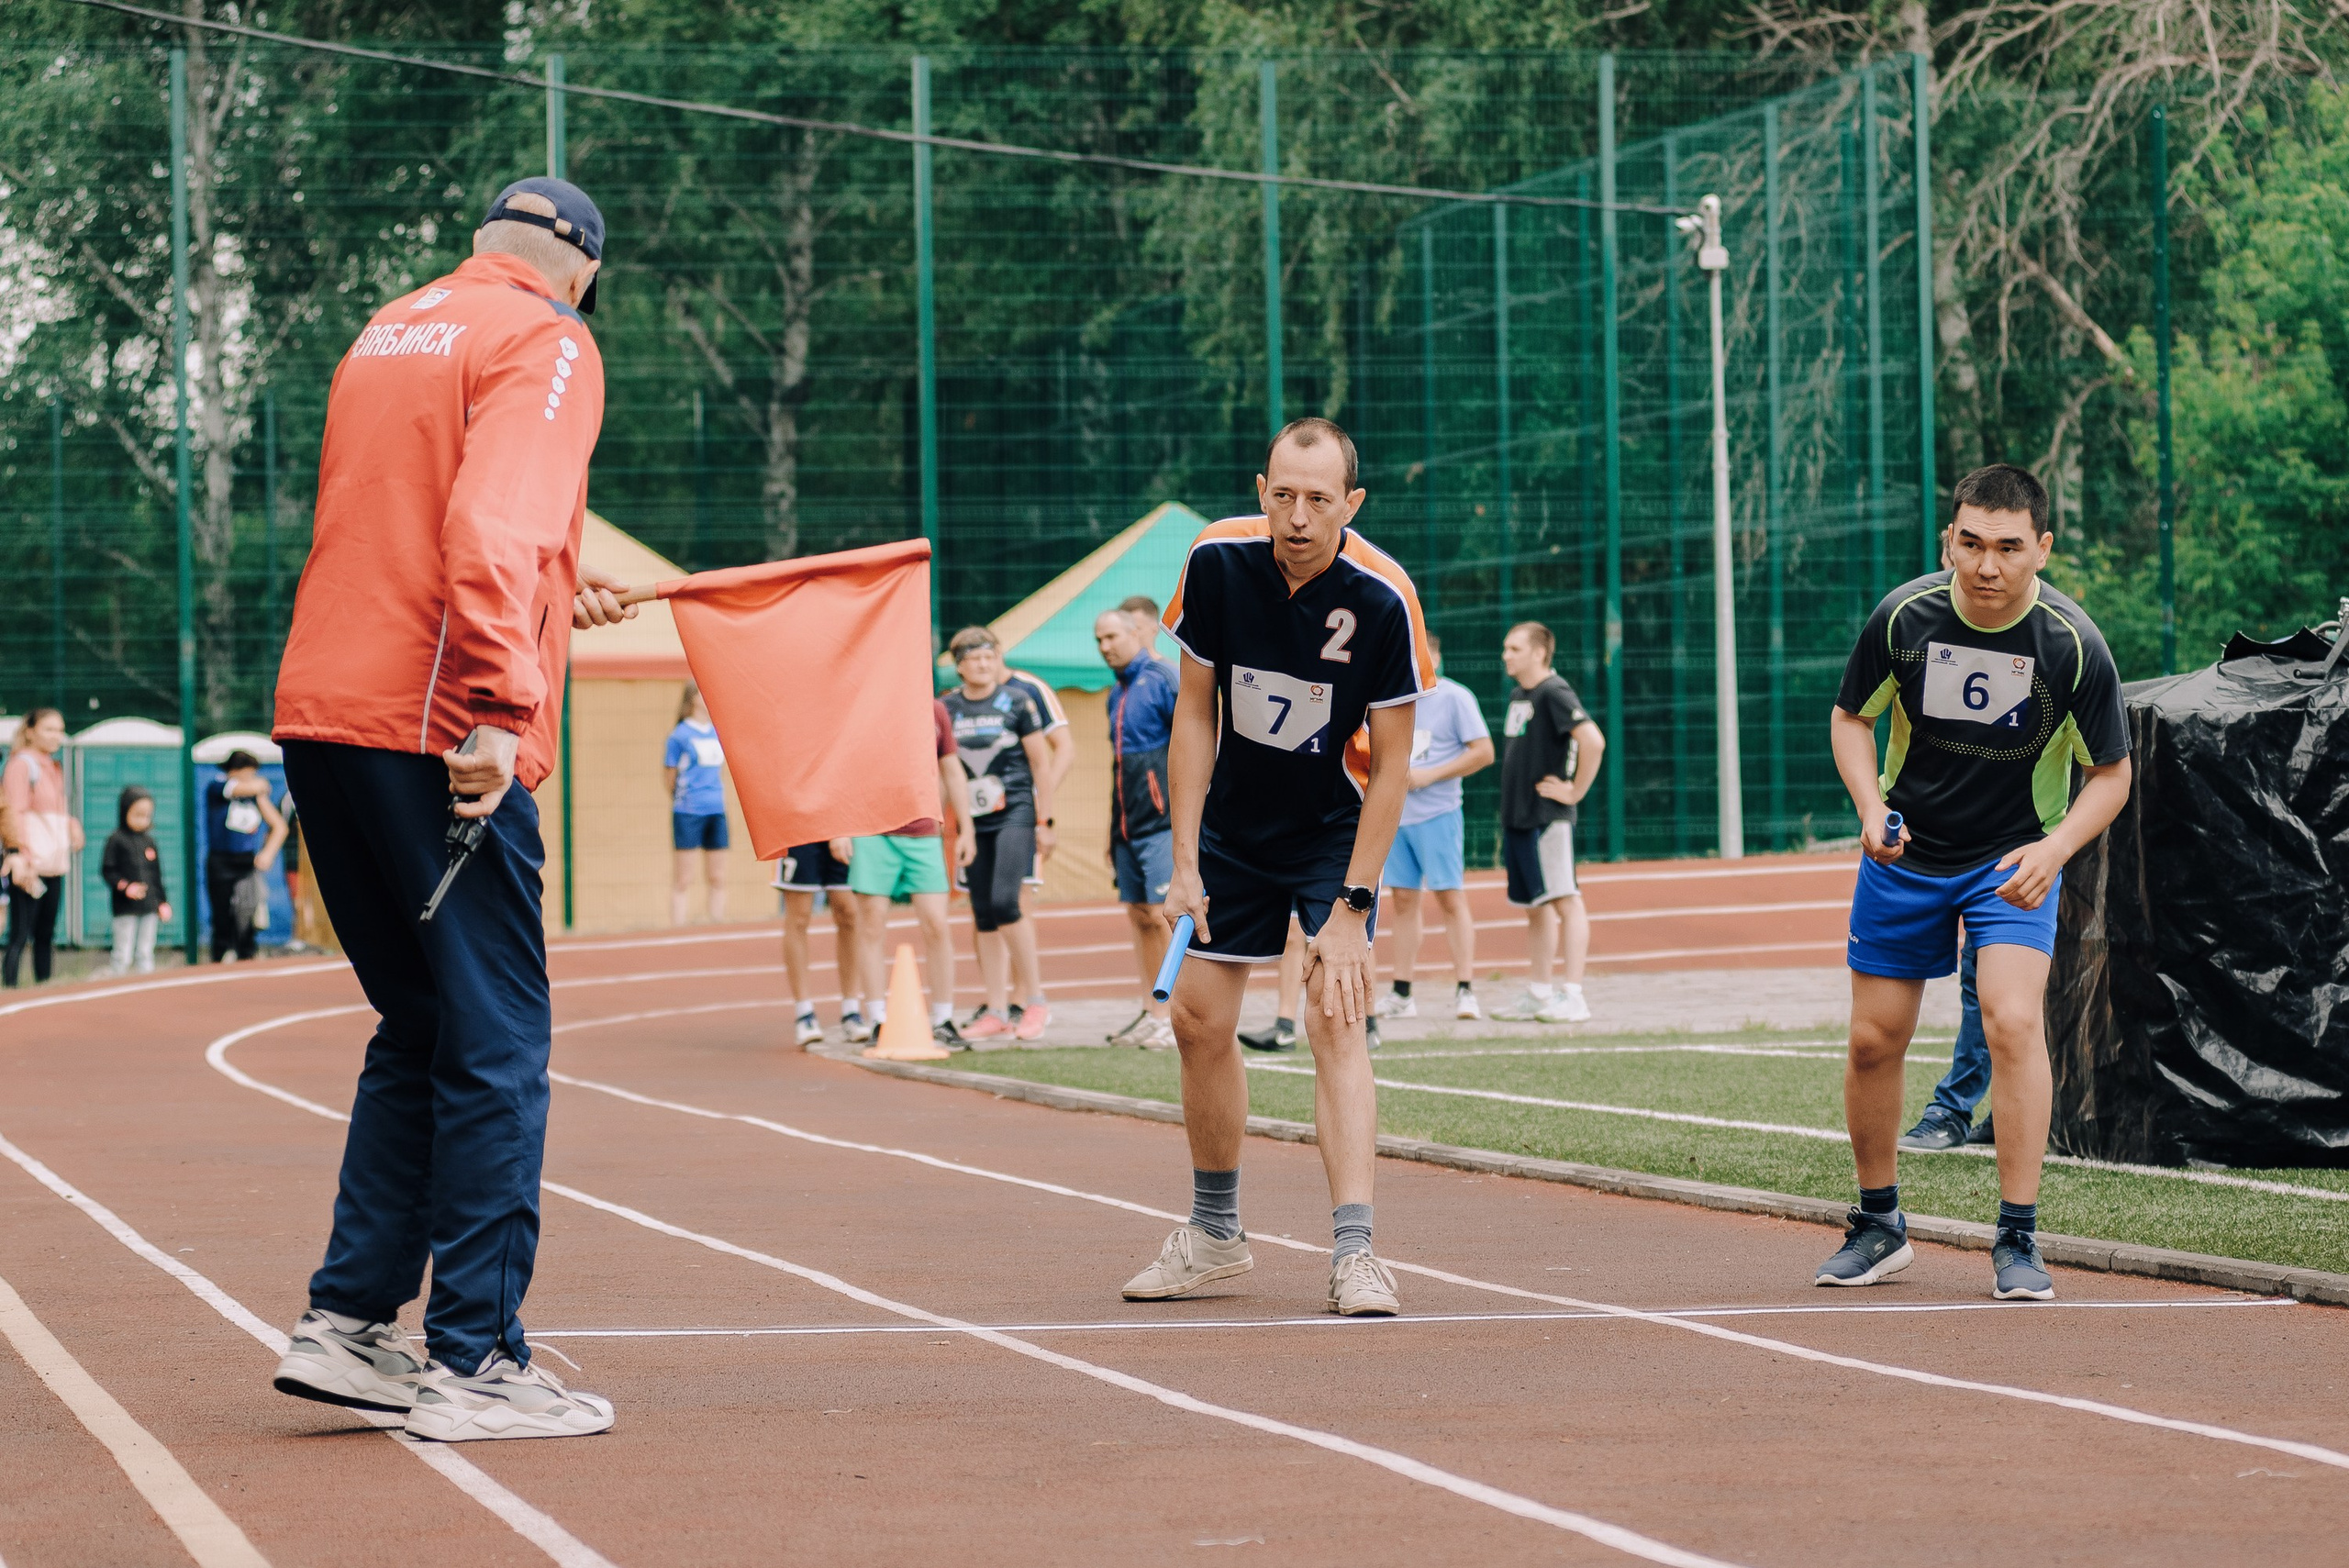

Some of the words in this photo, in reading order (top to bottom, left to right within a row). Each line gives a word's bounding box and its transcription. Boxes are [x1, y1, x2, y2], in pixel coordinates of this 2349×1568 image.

[349, 322, 468, 361] ЕЛЯБИНСК
[1320, 607, 1357, 663] 2
[1962, 672, 1989, 710] 6
[1268, 695, 1292, 735] 7
[2009, 711, 2019, 727] 1
[1310, 738, 1320, 752] 1
[975, 789, 987, 807] 6
